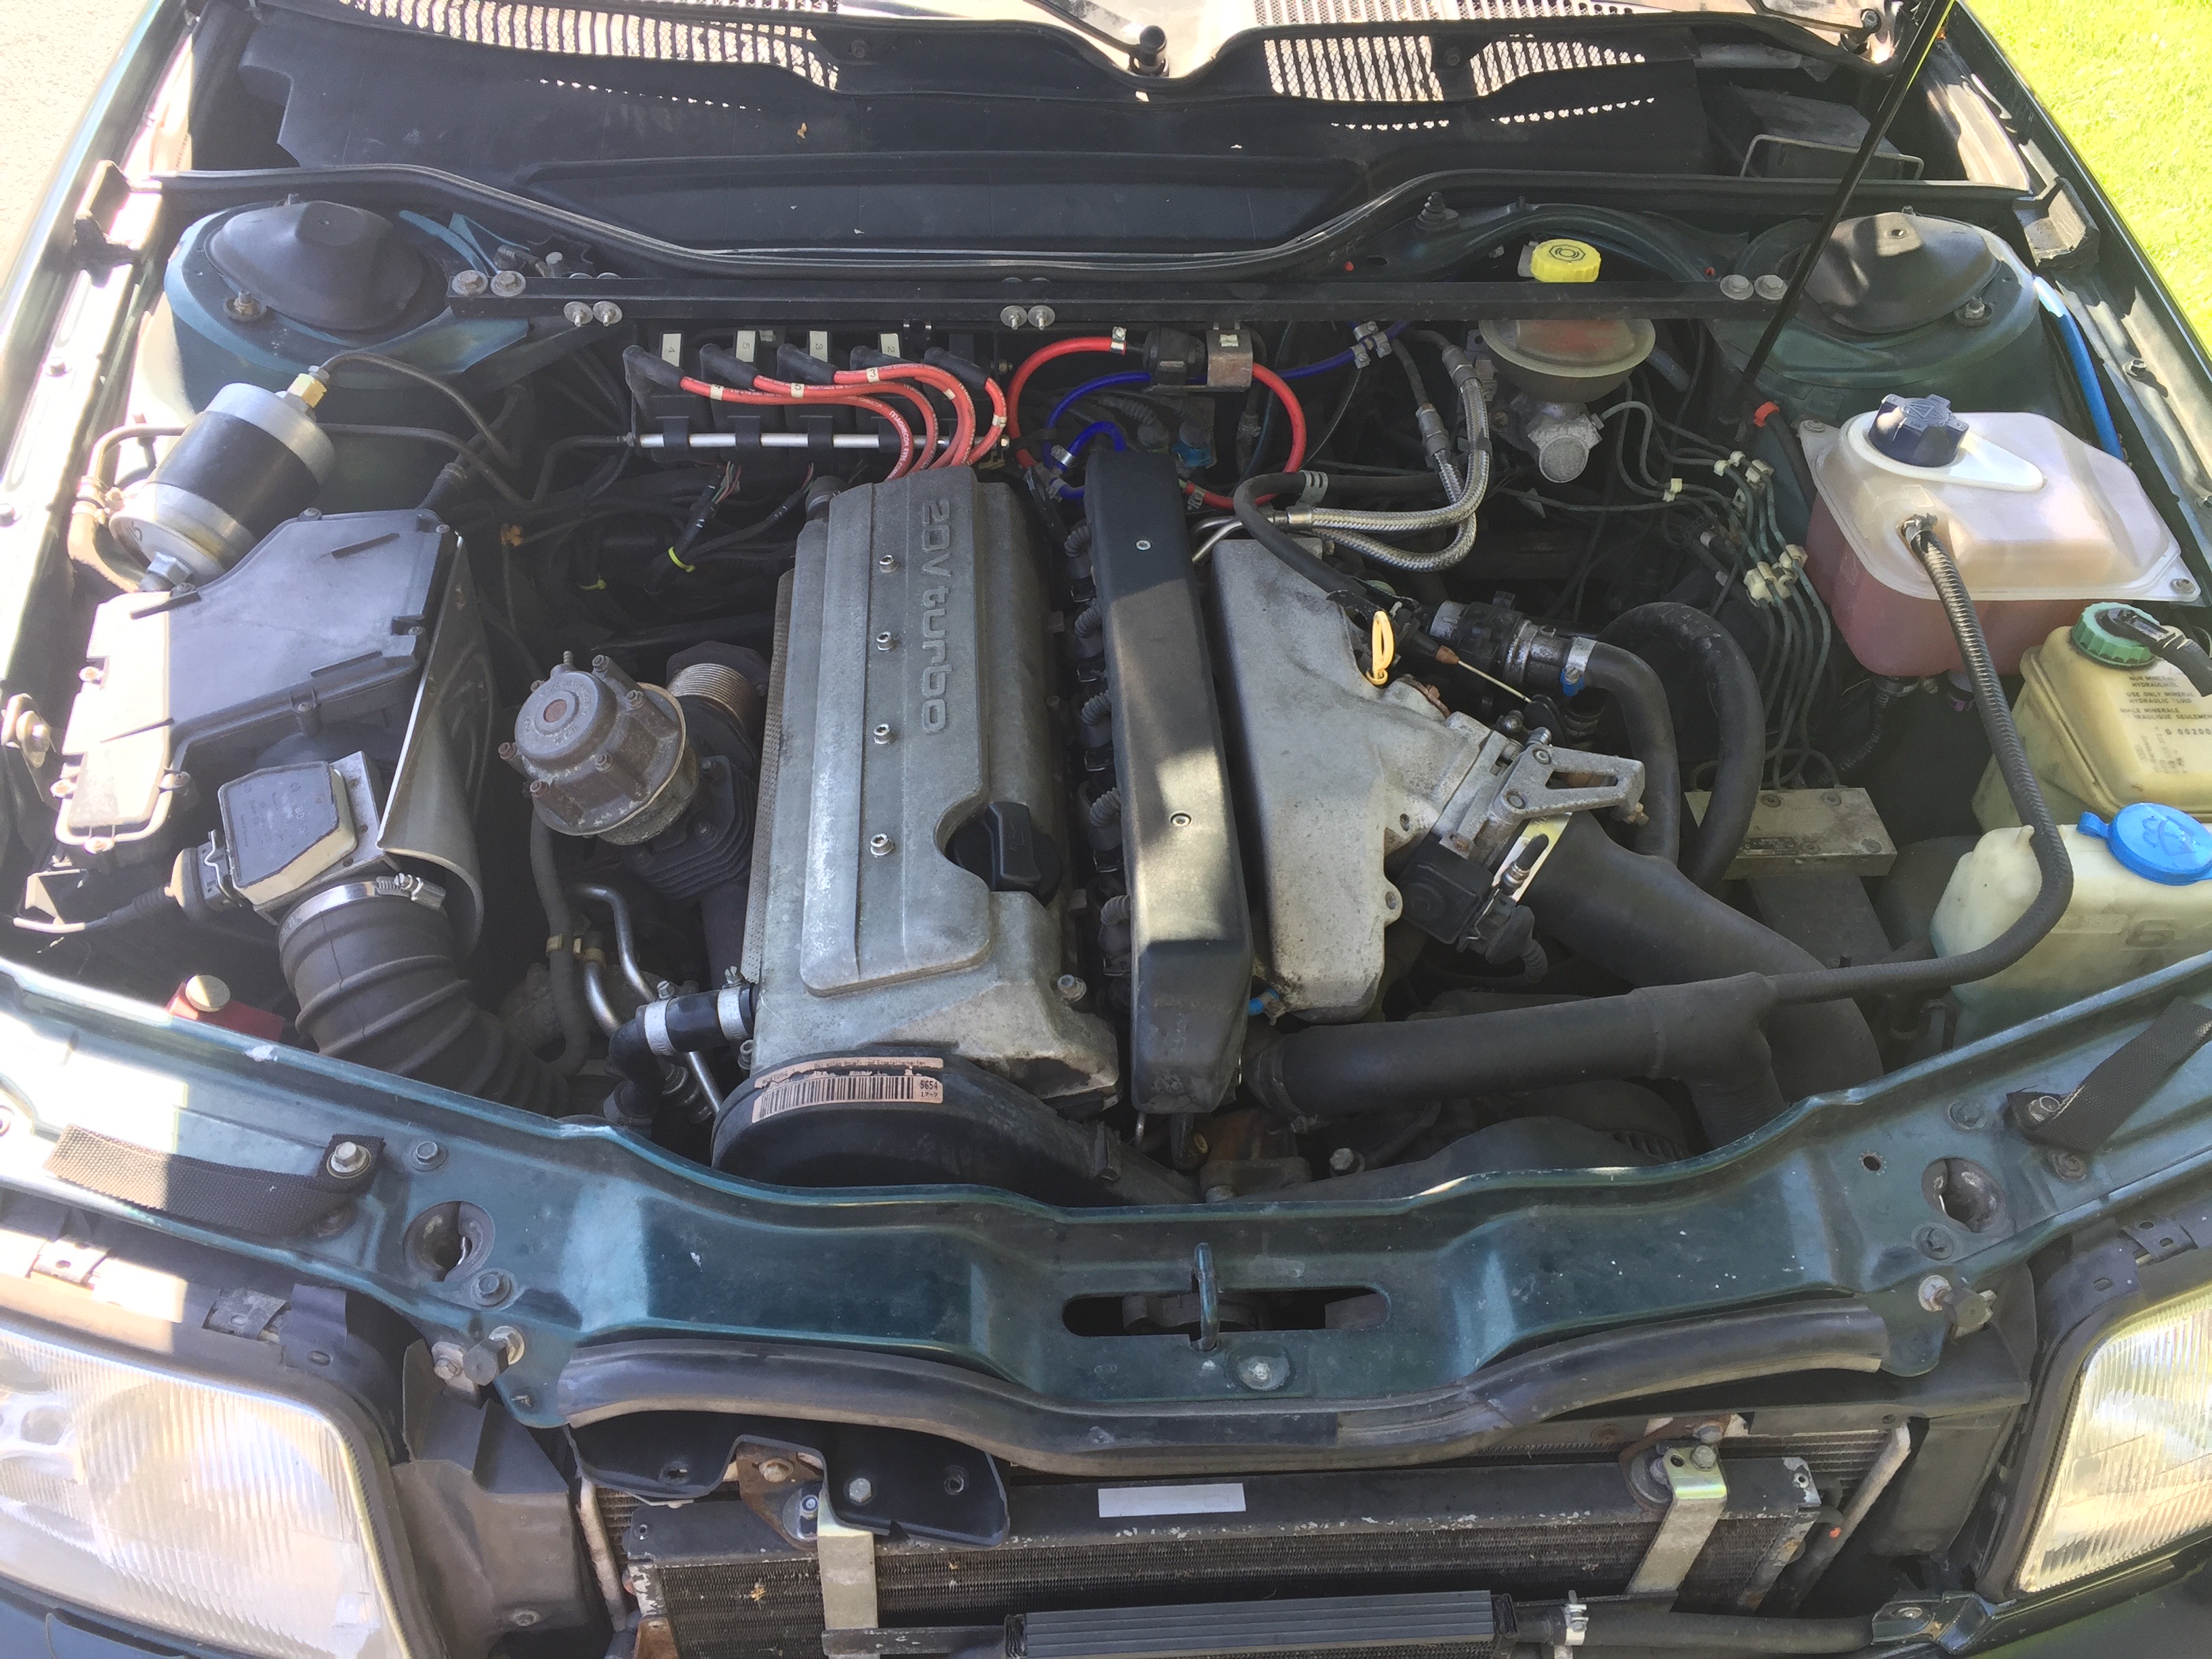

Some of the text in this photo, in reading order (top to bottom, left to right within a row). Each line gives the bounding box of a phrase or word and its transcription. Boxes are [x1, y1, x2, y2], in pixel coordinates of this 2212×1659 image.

[869, 369, 876, 378] 3
[888, 409, 909, 447] MAGNECOR
[922, 499, 951, 577] 20V
[921, 585, 954, 734] turbo
[920, 1080, 938, 1090] 5654
